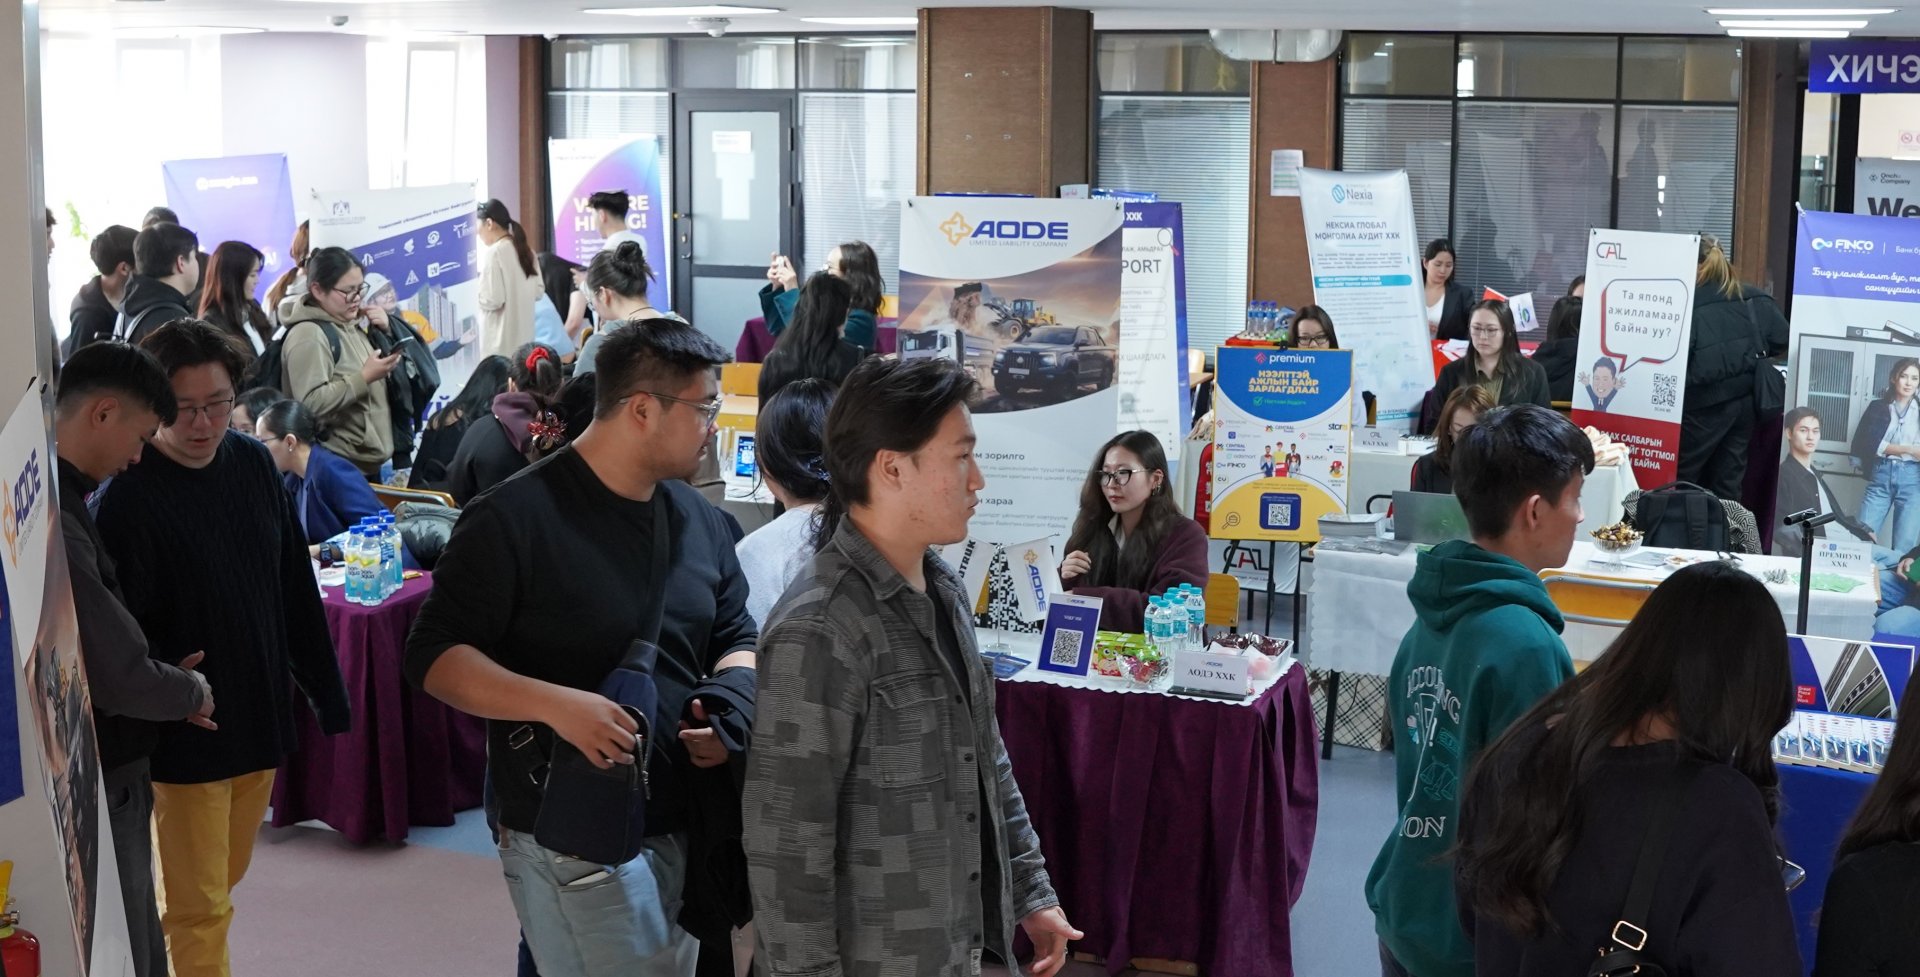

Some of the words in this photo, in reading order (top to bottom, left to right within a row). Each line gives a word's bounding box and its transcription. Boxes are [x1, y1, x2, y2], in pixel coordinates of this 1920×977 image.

[1346, 188, 1373, 200] Nexia
[971, 220, 1069, 240] AODE
[1325, 221, 1356, 229] НЕКСИА
[1356, 221, 1387, 229] ГЛОБАЛ
[1314, 232, 1356, 241] МОНГОЛИА
[1358, 232, 1383, 241] АУДИТ
[1385, 232, 1401, 240] ХХК
[1032, 240, 1069, 248] COMPANY
[1835, 239, 1874, 250] FINCO
[1622, 290, 1634, 300] Та
[1638, 294, 1673, 305] японд
[1608, 306, 1681, 323] ажилламаар
[1614, 321, 1648, 335] байна
[1652, 327, 1672, 338] уу?
[1269, 353, 1316, 364] premium
[1258, 370, 1310, 379] НЭЭЛТТЭЙ
[1249, 377, 1289, 386] АЖЛЫН
[1291, 378, 1319, 387] БАЙР
[1248, 384, 1319, 394] ЗАРЛАГДЛАА!
[1621, 434, 1663, 447] САЛБАРЫН
[985, 452, 1025, 460] зорилго
[1641, 448, 1675, 461] ТОГТМОЛ
[1634, 458, 1661, 470] БАЙНА
[14, 447, 41, 536] AODE
[985, 497, 1013, 505] хараа
[1819, 551, 1861, 560] ПРЕМИУМ
[1831, 560, 1848, 568] ХХК
[1028, 564, 1046, 612] AODE
[1187, 669, 1214, 681] АОДЭ
[1215, 671, 1236, 681] ХХК
